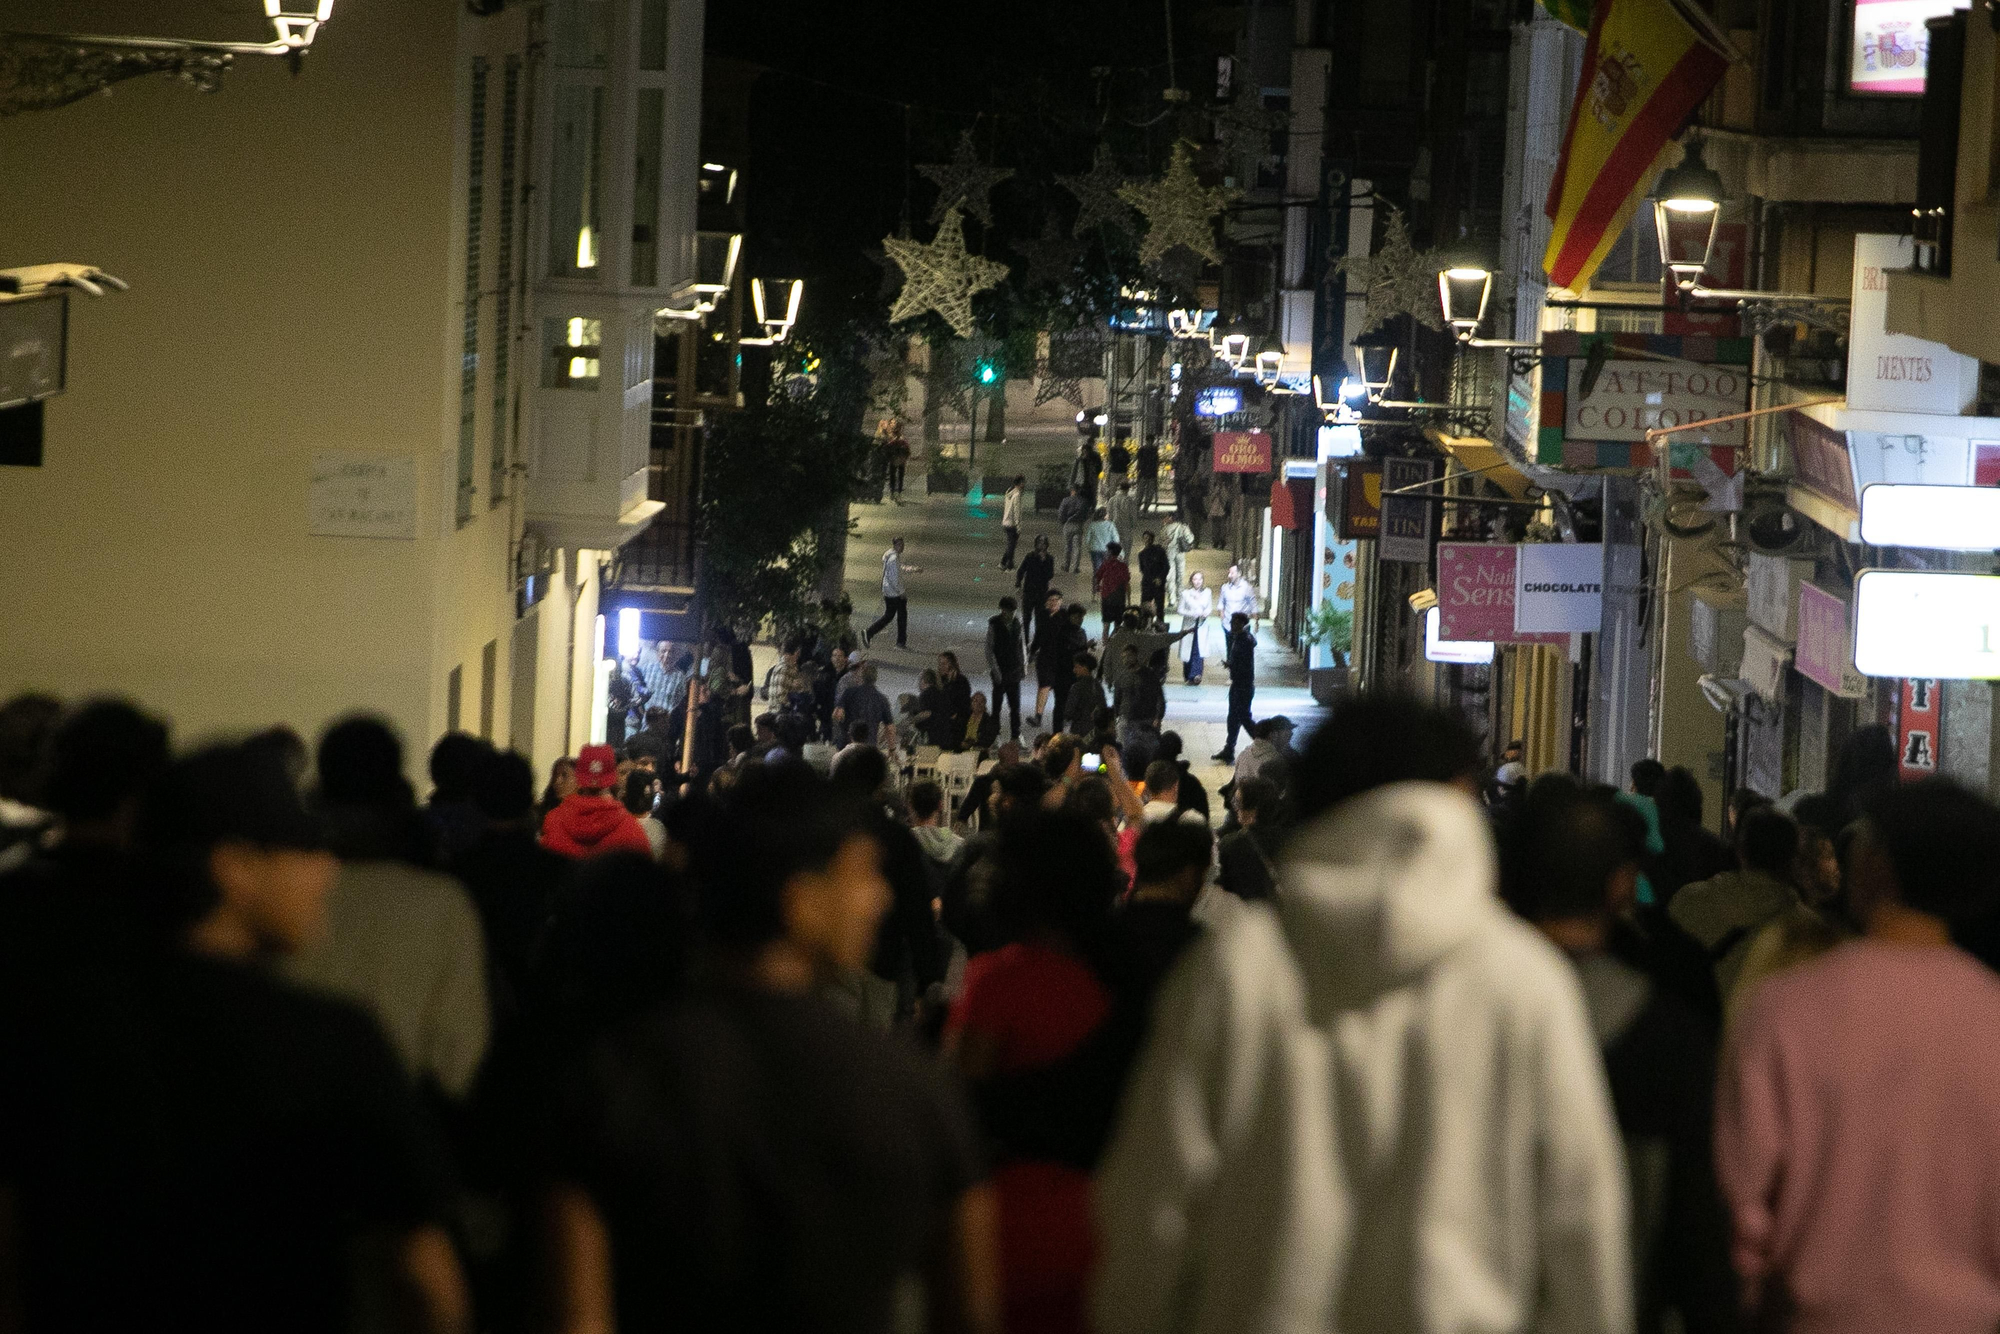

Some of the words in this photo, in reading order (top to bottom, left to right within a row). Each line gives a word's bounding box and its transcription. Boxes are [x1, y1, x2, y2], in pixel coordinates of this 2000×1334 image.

[1876, 355, 1933, 382] DIENTES
[1600, 370, 1738, 396] ATTOO
[1577, 405, 1735, 433] COLORS
[1228, 443, 1258, 455] ORO
[1220, 454, 1265, 466] OLMOS
[1523, 582, 1601, 594] CHOCOLATE
